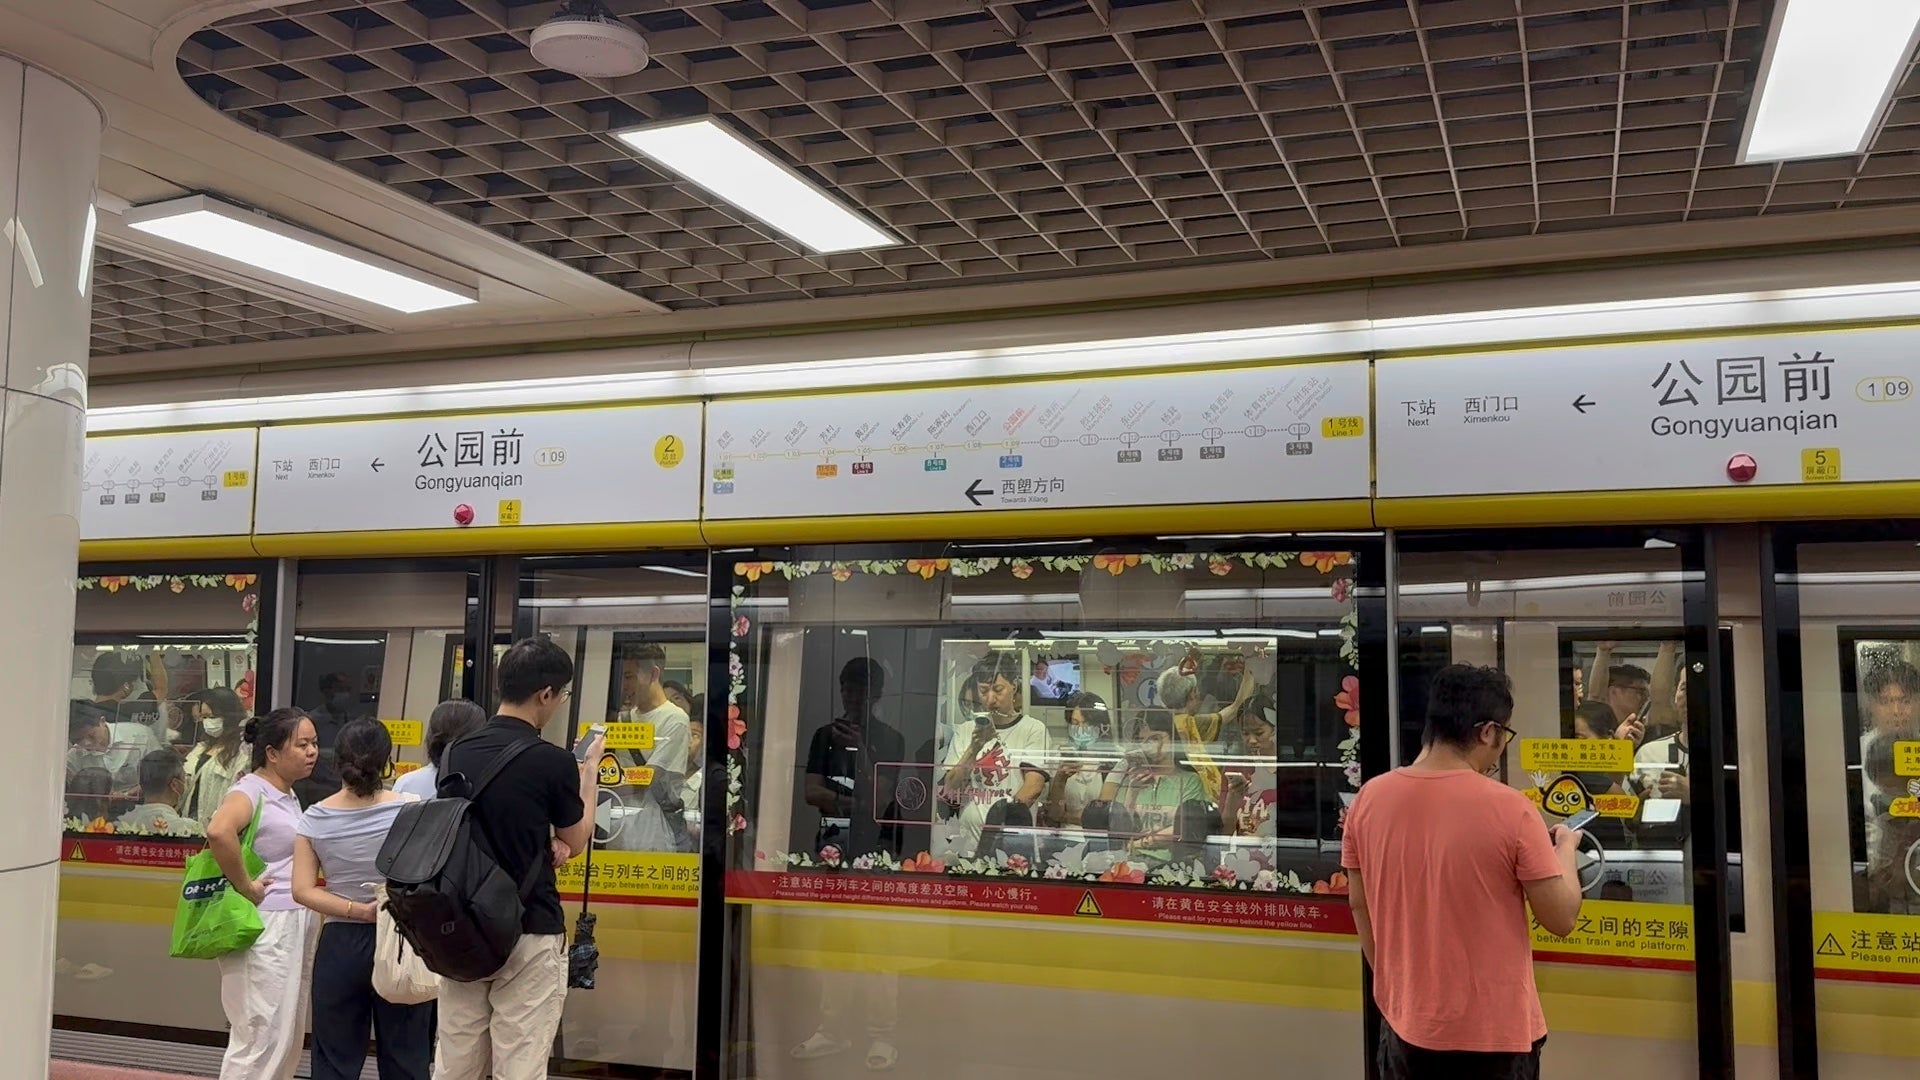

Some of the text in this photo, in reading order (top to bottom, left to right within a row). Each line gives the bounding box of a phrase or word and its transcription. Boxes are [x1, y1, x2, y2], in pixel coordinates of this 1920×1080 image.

[1651, 351, 1835, 407] 公园前
[1868, 381, 1909, 397] 1 09
[1401, 398, 1436, 416] 下站
[1464, 395, 1518, 413] 西门口
[1328, 418, 1359, 429] 1号线
[1407, 418, 1429, 427] Next
[1463, 414, 1510, 424] Ximenkou
[1651, 410, 1837, 439] Gongyuanqian
[417, 428, 524, 468] 公园前
[665, 434, 675, 452] 2
[309, 458, 340, 470] 西门口
[550, 451, 565, 462] 09
[1815, 450, 1826, 465] 5
[273, 460, 293, 473] 下站
[414, 472, 523, 492] Gongyuanqian
[1001, 476, 1065, 494] 西塱方向
[506, 501, 513, 512] 4
[590, 880, 600, 888] the
[603, 882, 617, 890] gap
[619, 881, 649, 890] between
[652, 882, 669, 890] train
[778, 876, 1038, 901] 注意站台与列车之间的高度差及空隙，小心慢行。
[1152, 896, 1329, 919] 请在黄色安全线外排队候车。
[1532, 913, 1689, 939] 之间的空隙
[1536, 934, 1689, 951] between train and platform.
[1851, 930, 1920, 951] 注意站
[1851, 952, 1892, 963] Please
